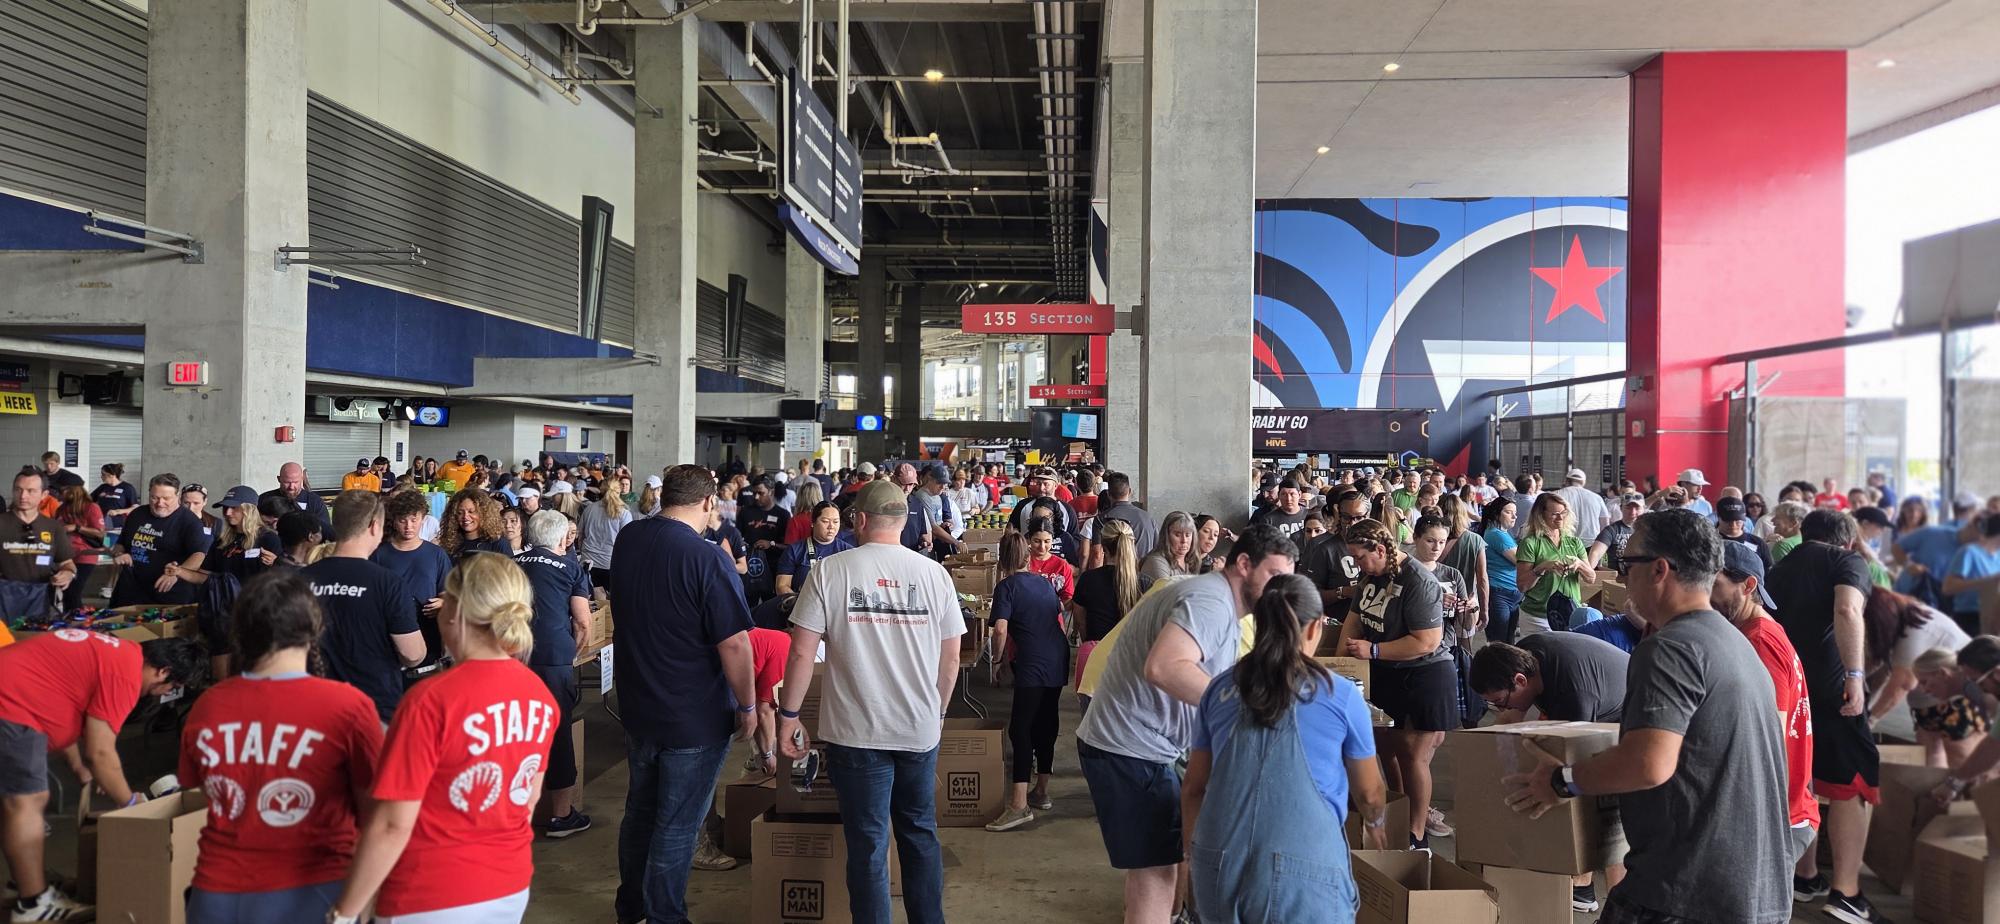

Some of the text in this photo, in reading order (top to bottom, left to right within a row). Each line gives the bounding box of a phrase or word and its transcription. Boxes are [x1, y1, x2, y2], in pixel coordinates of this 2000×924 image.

[984, 311, 1017, 326] 135
[175, 363, 200, 383] EXIT
[1039, 388, 1056, 396] 134
[4, 395, 33, 410] HERE
[1290, 415, 1309, 429] GO
[1265, 439, 1287, 447] HIVE
[133, 532, 156, 543] BANK
[131, 540, 157, 551] LOCAL.
[310, 581, 368, 598] lunteer
[877, 578, 901, 588] BELL
[463, 699, 554, 757] STAFF
[196, 721, 326, 769] STAFF
[952, 777, 976, 786] 6TH
[952, 787, 976, 796] MAN
[787, 886, 819, 900] 6TH
[787, 900, 819, 913] MAN
